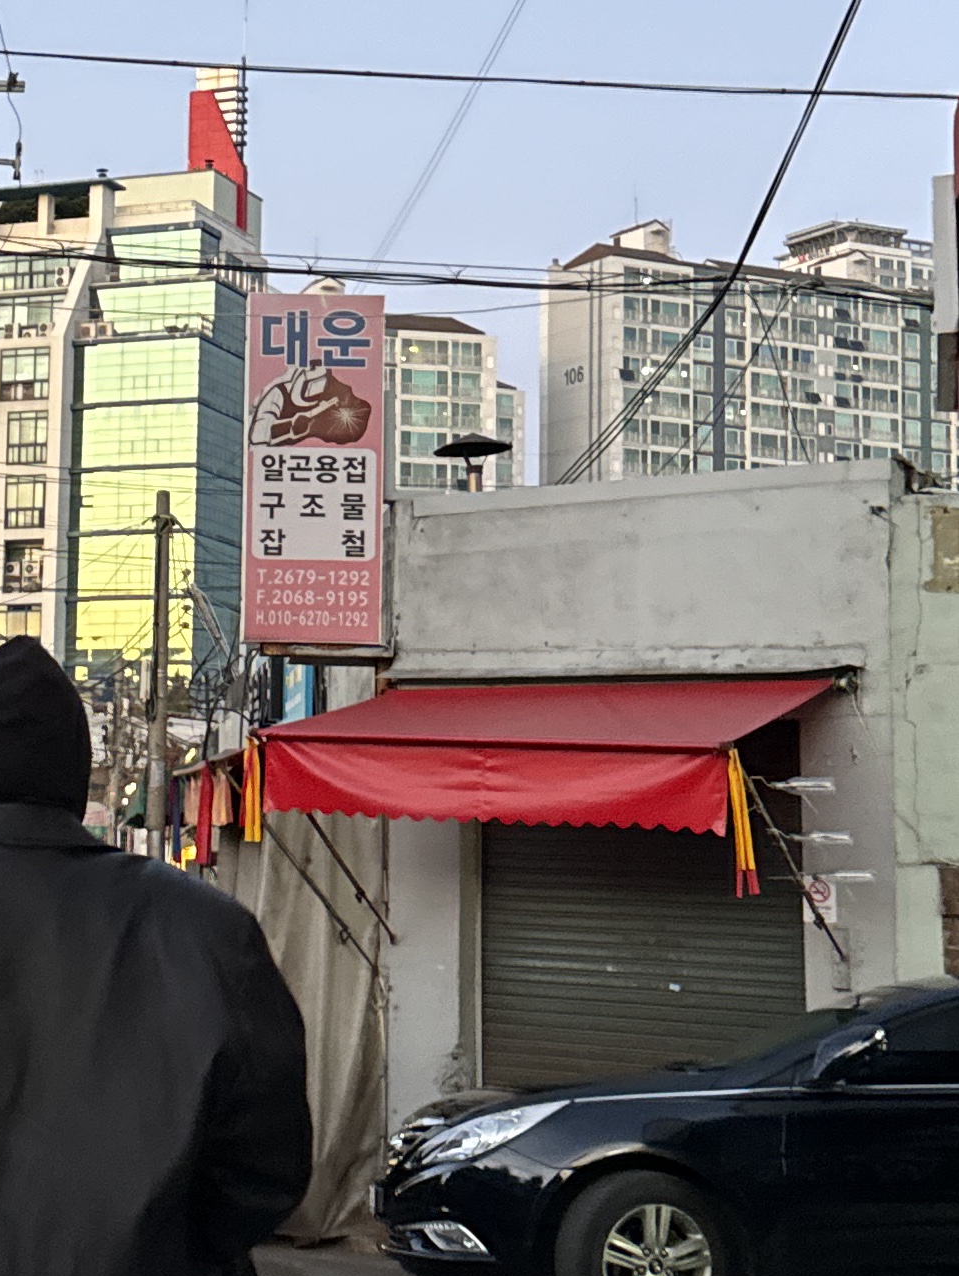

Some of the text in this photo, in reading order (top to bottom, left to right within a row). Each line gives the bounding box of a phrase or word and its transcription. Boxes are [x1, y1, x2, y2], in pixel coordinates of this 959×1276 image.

[260, 310, 373, 368] 대운
[563, 365, 584, 386] 106
[261, 454, 368, 484] 알곤용접
[257, 568, 370, 586] T.2679-1292
[256, 589, 369, 607] F.2068-9195
[255, 609, 369, 627] H.010-6270-1292
